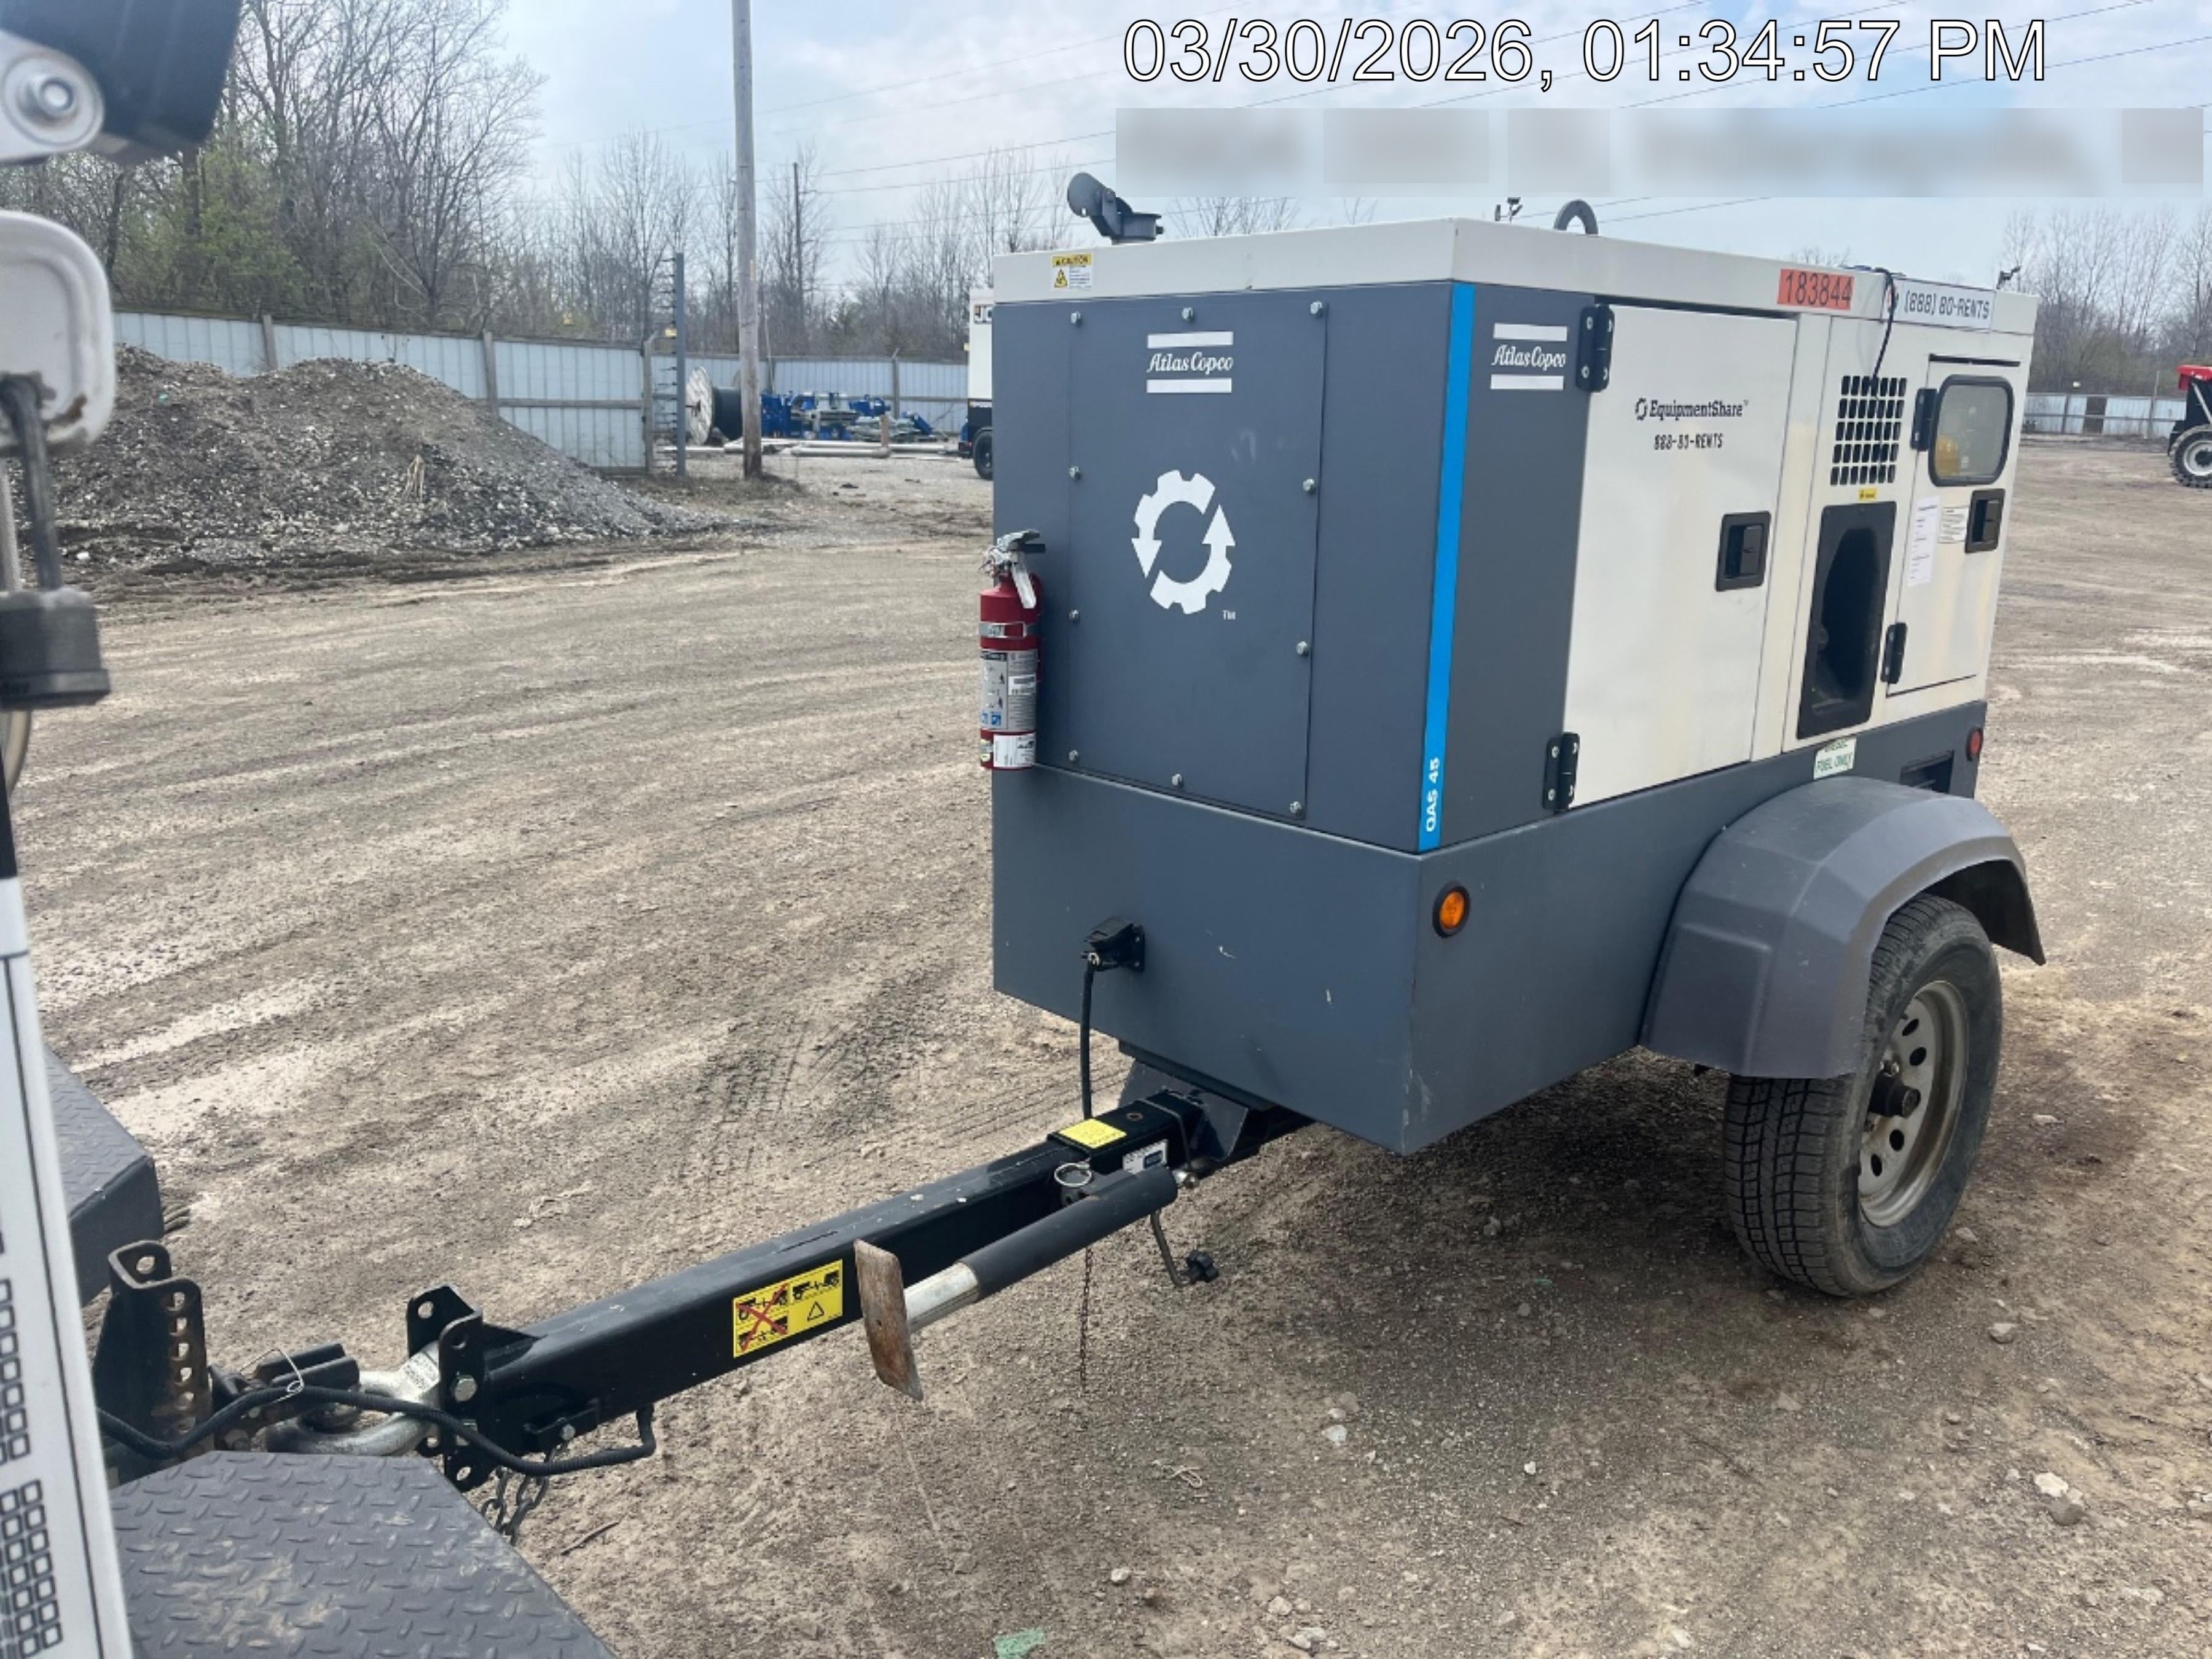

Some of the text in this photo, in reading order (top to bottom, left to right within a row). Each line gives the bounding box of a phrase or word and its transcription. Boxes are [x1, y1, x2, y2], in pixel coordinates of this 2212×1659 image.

[1786, 270, 1852, 306] 183844
[1905, 291, 1990, 319] (888) 80-RENTS
[1146, 351, 1234, 375] Atlas Copco
[1491, 344, 1566, 371] Atlas Copco
